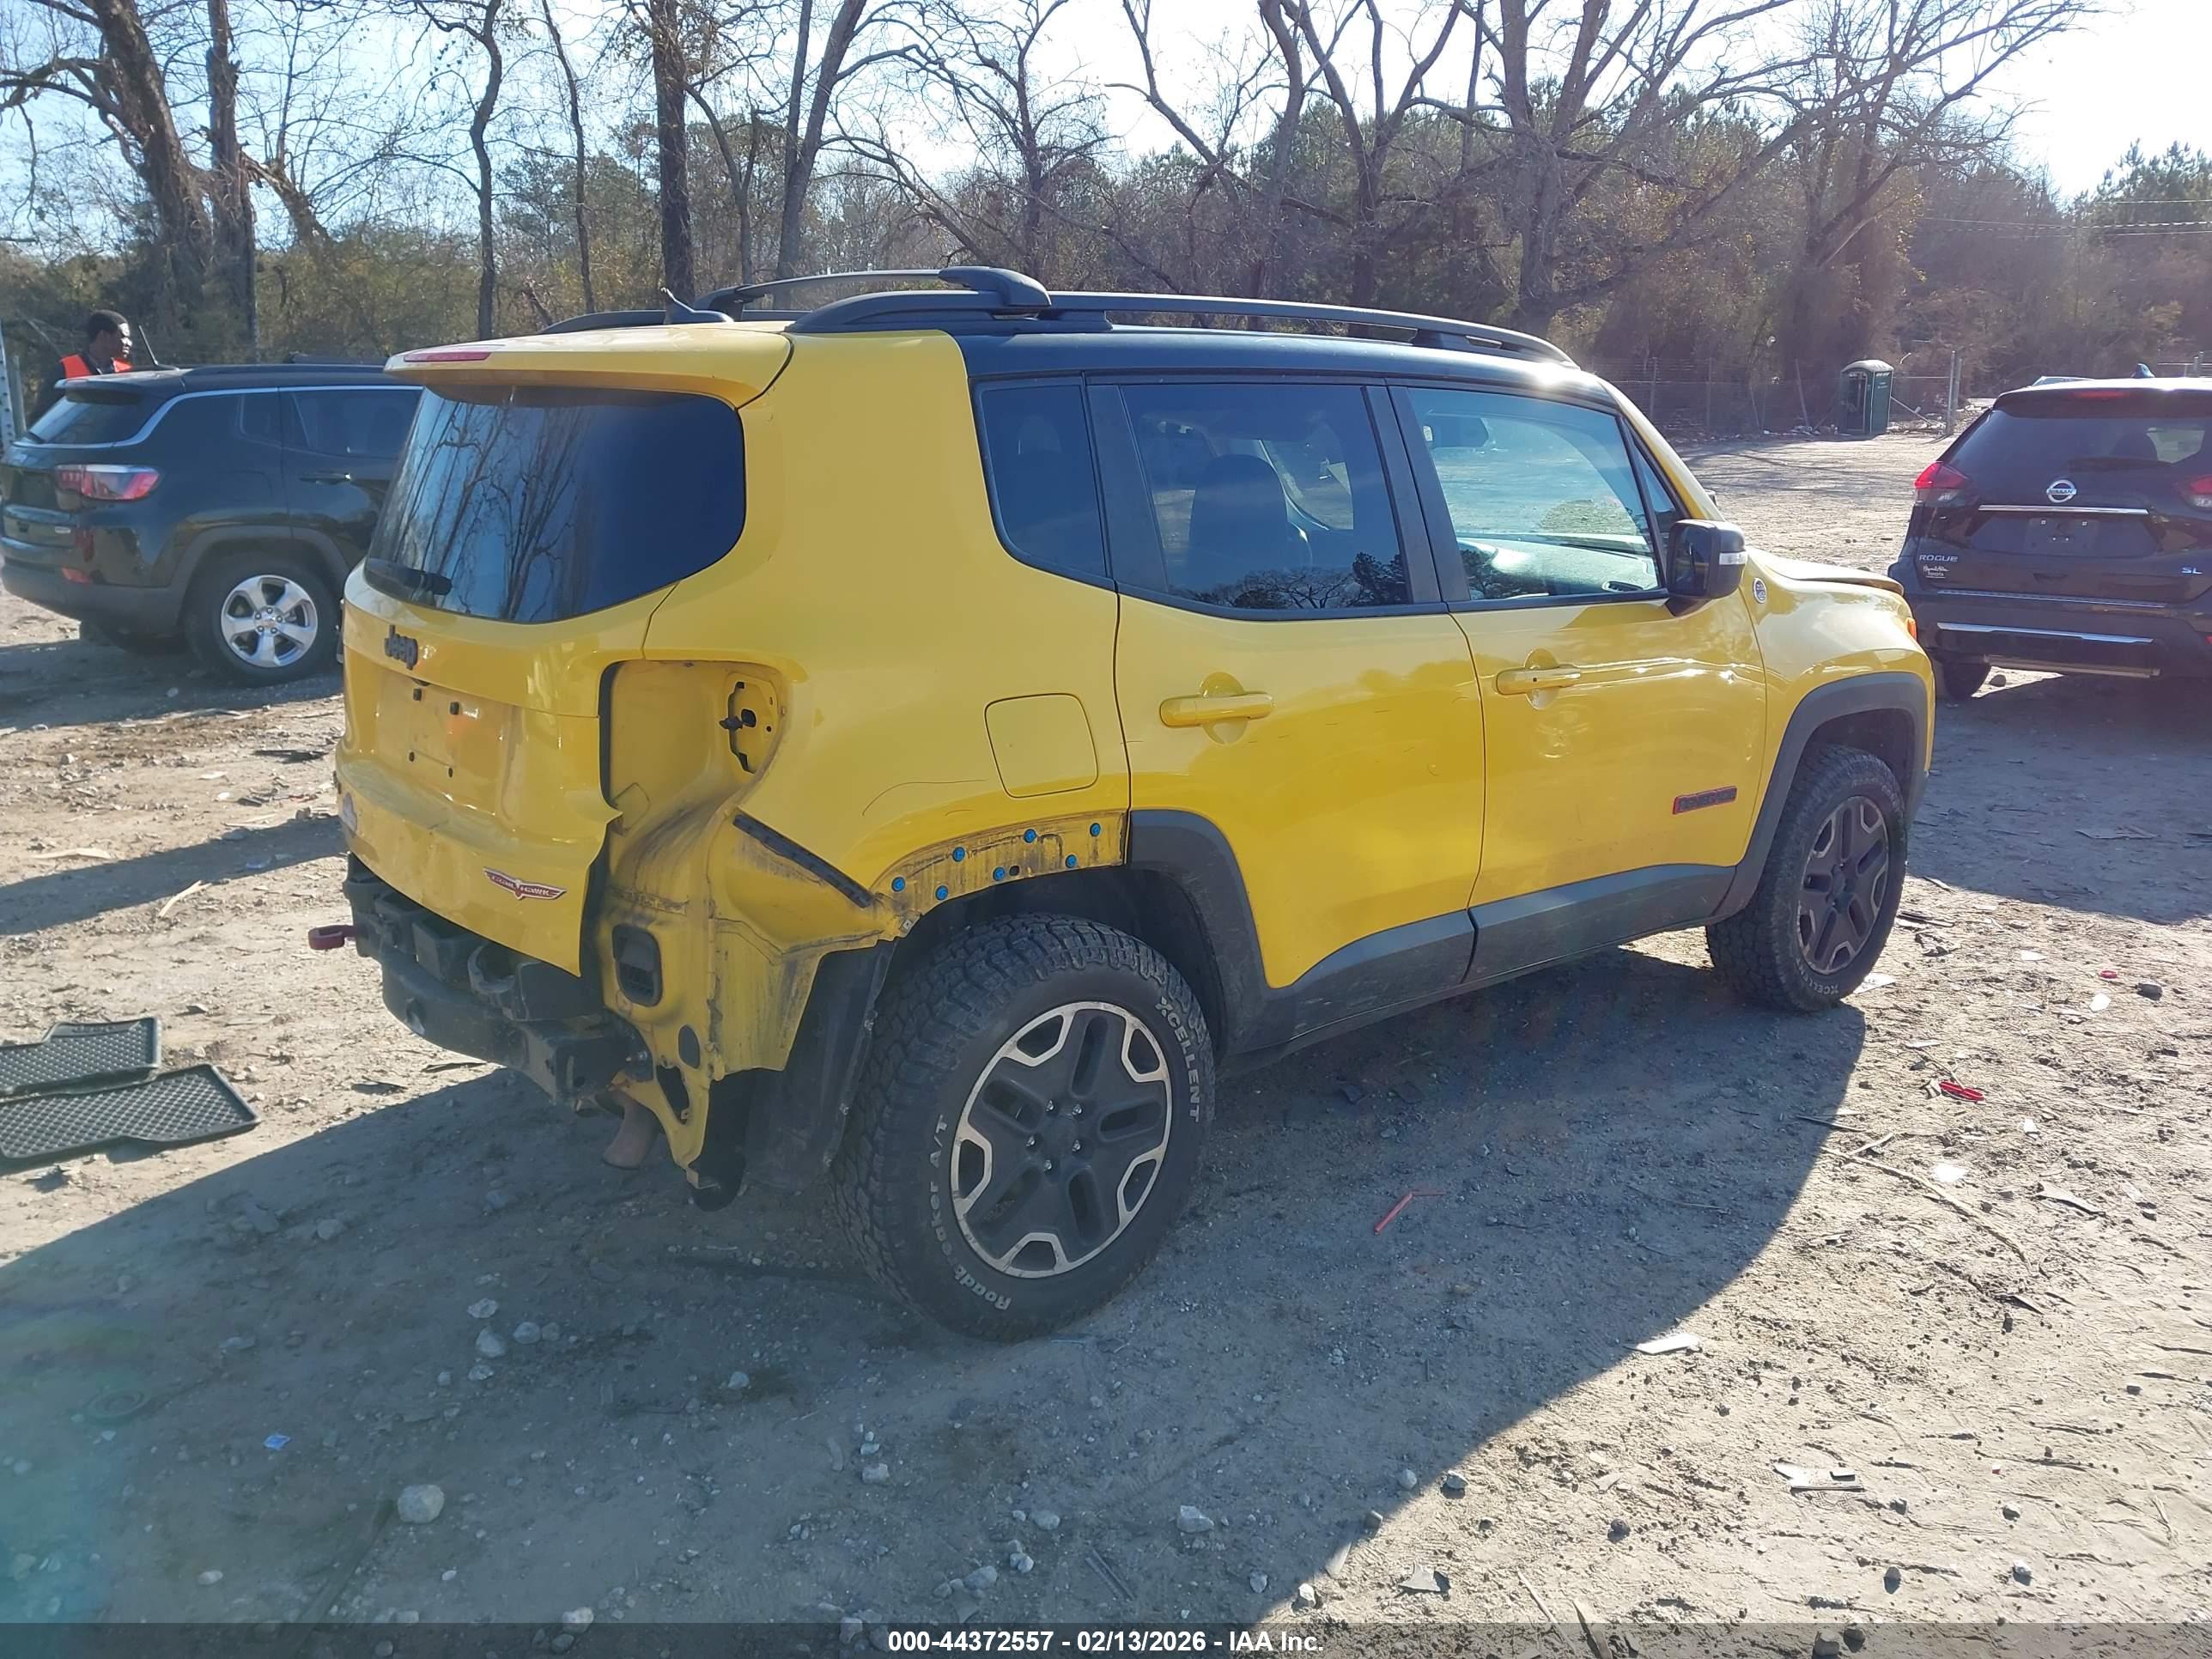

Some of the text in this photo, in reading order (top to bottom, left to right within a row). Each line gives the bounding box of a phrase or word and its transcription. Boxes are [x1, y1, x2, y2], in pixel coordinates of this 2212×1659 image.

[1918, 554, 1959, 562] ROGUE
[1155, 996, 1201, 1123] XCELLENT
[929, 1114, 948, 1169] A/T
